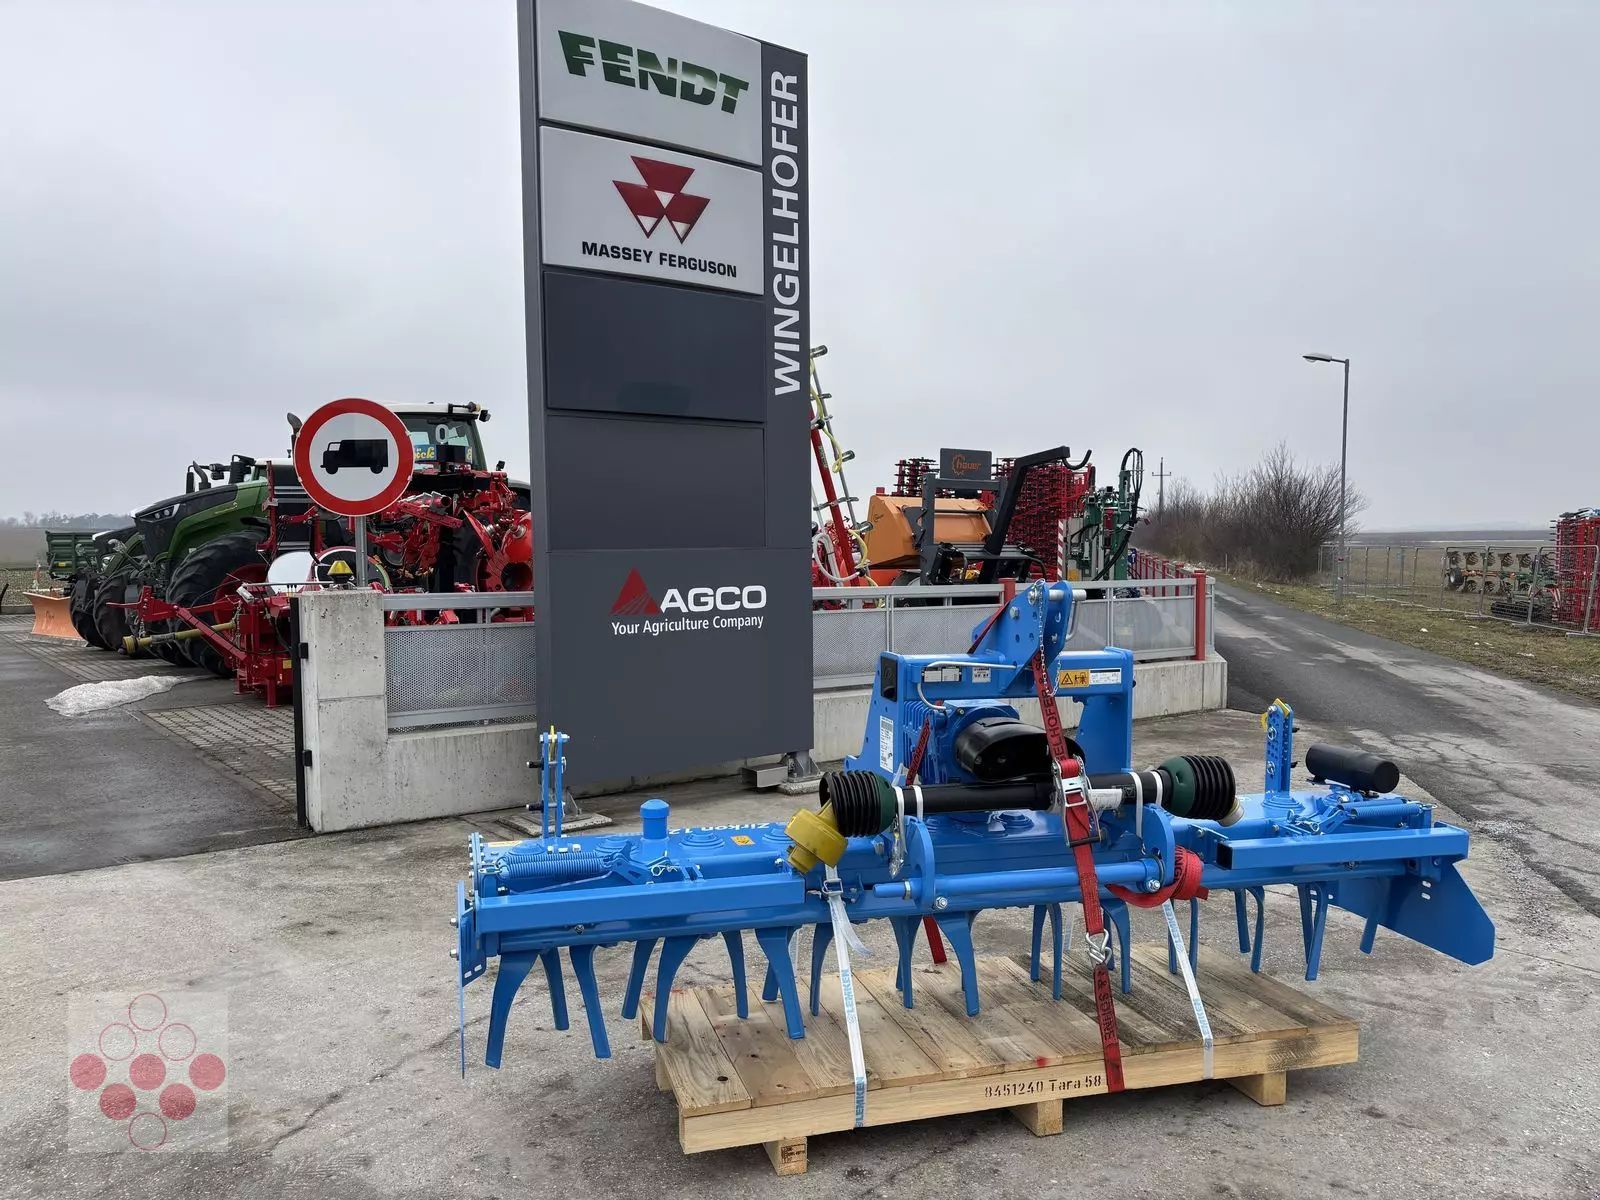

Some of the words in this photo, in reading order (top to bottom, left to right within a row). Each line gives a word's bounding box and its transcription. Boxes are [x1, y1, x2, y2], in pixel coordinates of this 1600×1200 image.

[558, 30, 749, 114] FENDT
[770, 71, 801, 396] WINGELHOFER
[582, 241, 653, 264] MASSEY
[659, 252, 737, 277] FERGUSON
[660, 585, 767, 613] AGCO
[611, 622, 640, 635] Your
[643, 617, 710, 636] Agriculture
[713, 615, 764, 630] Company
[841, 969, 855, 1014] LEMKEN
[855, 1076, 865, 1123] LEMKEN
[985, 1080, 1044, 1098] 8451240
[1048, 1079, 1081, 1092] Tara
[1085, 1075, 1101, 1088] 58
